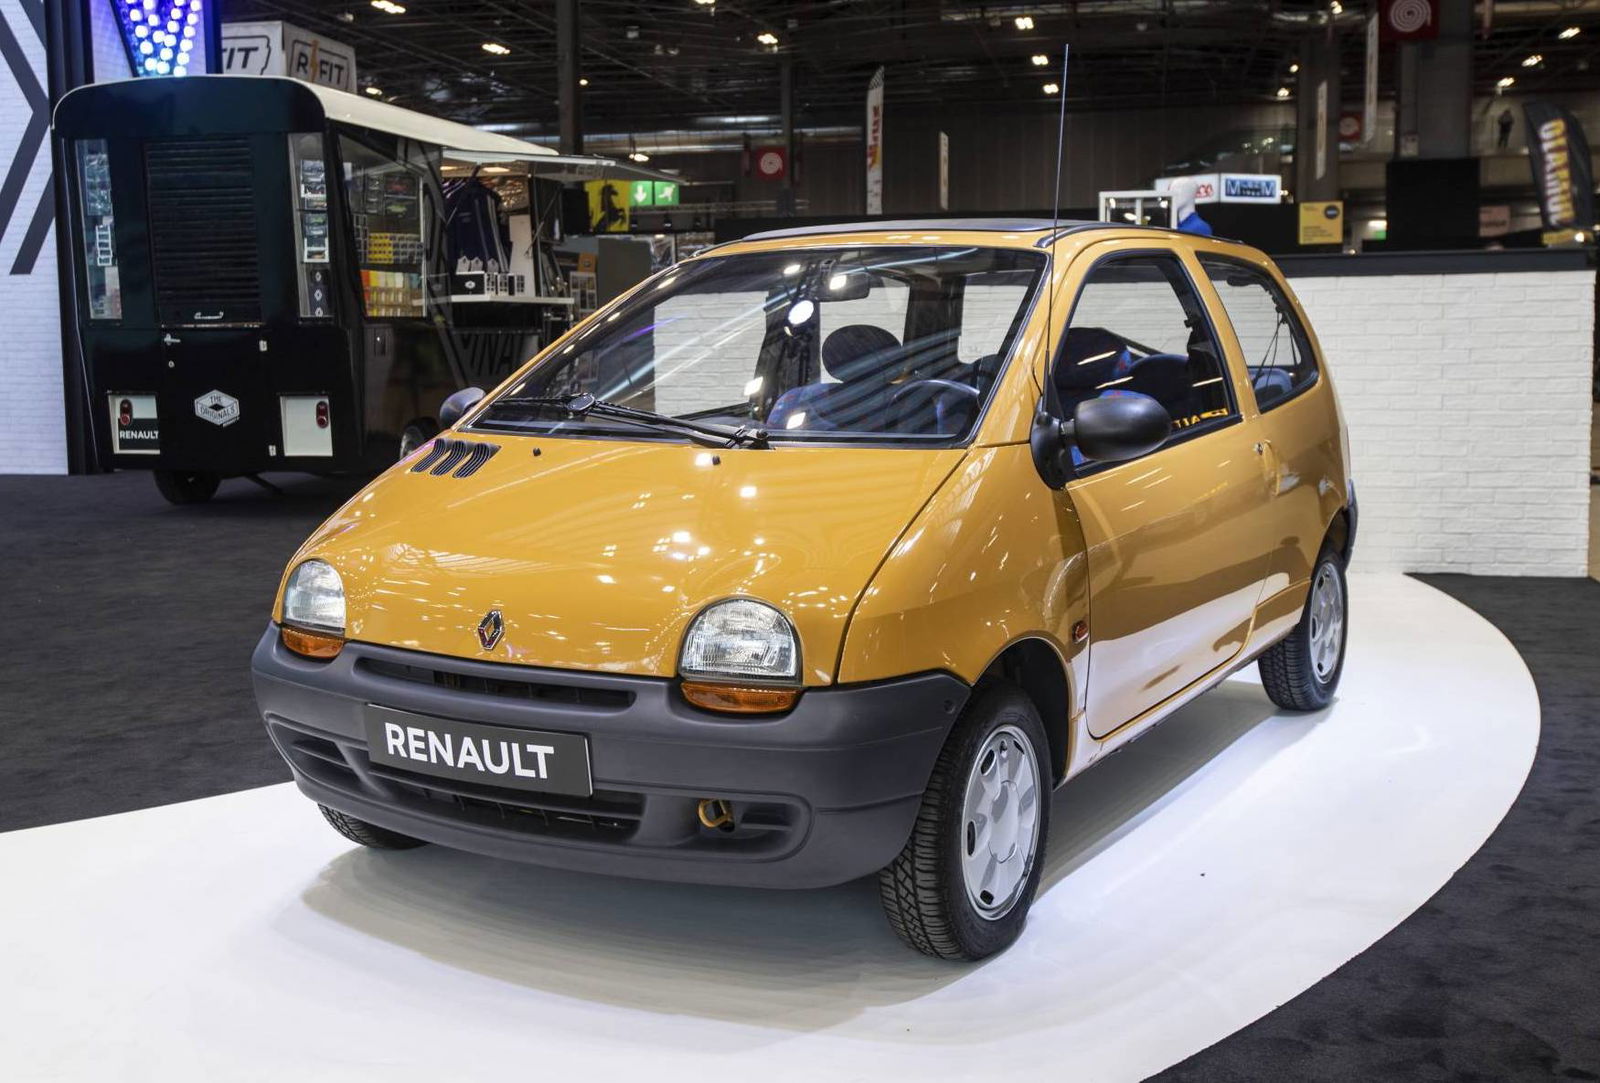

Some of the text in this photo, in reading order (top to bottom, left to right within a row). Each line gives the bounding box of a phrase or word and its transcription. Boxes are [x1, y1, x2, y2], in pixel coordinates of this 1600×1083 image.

[222, 46, 259, 70] IT
[210, 395, 222, 405] THE
[199, 404, 236, 420] ORIGINALS
[119, 430, 159, 440] RENAULT
[384, 722, 555, 779] RENAULT
